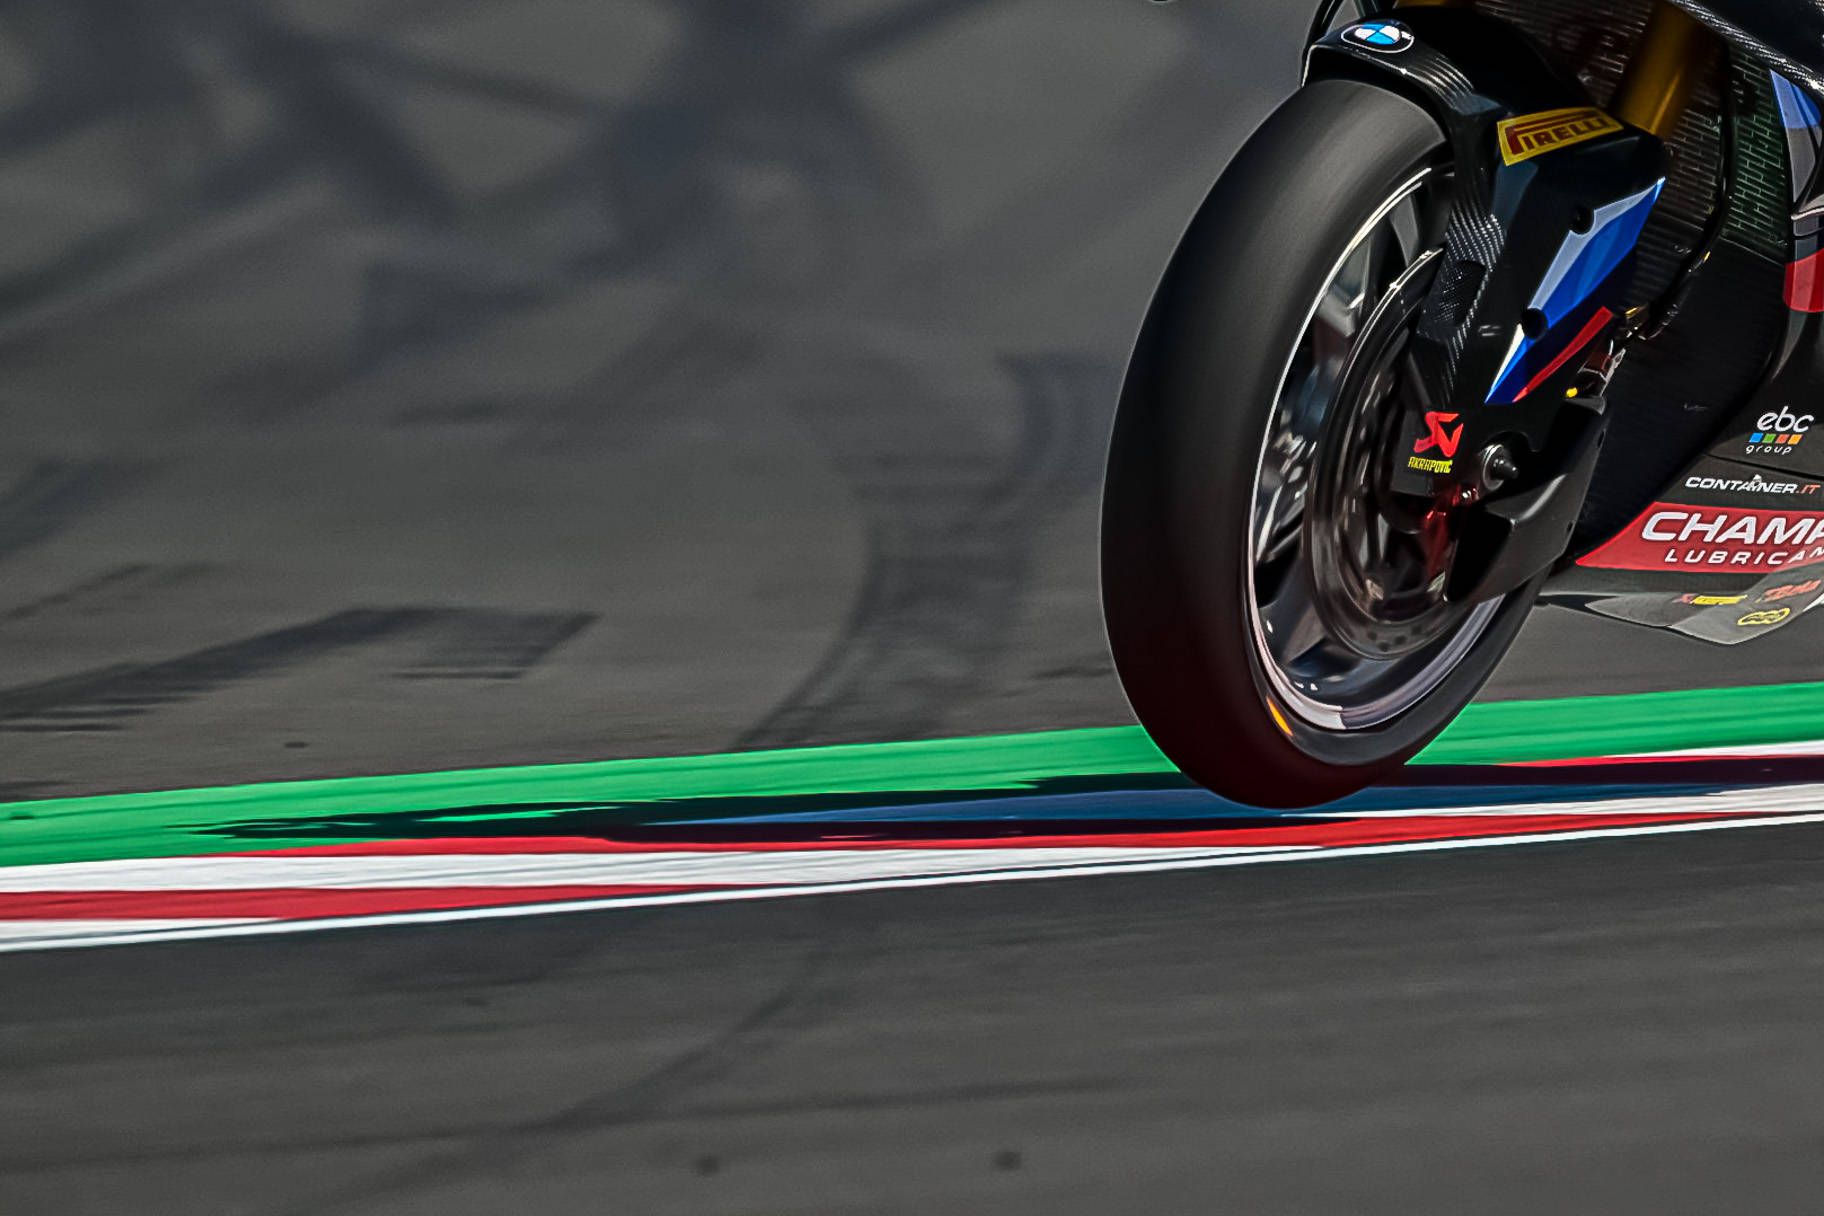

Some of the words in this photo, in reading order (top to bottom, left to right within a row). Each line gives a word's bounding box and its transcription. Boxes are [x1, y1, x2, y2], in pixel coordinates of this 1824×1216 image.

[1756, 405, 1815, 433] ebc
[1745, 444, 1793, 456] group
[1684, 475, 1821, 495] CONTAINER.IT
